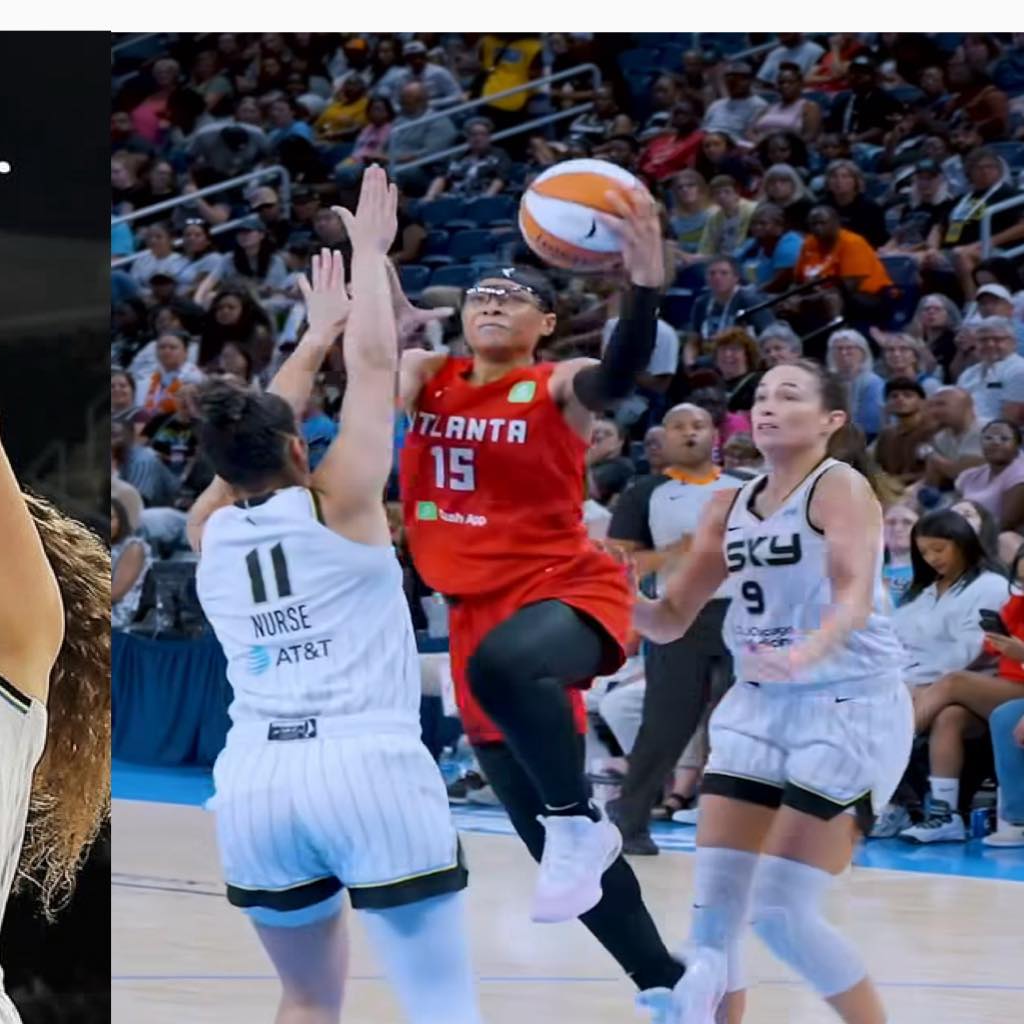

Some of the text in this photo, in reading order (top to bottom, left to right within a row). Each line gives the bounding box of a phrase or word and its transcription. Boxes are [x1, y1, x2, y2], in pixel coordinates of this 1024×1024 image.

[431, 445, 476, 491] 15
[245, 541, 292, 603] 11
[741, 580, 765, 615] 9
[251, 604, 312, 638] NURSE
[276, 639, 332, 667] AT&T
